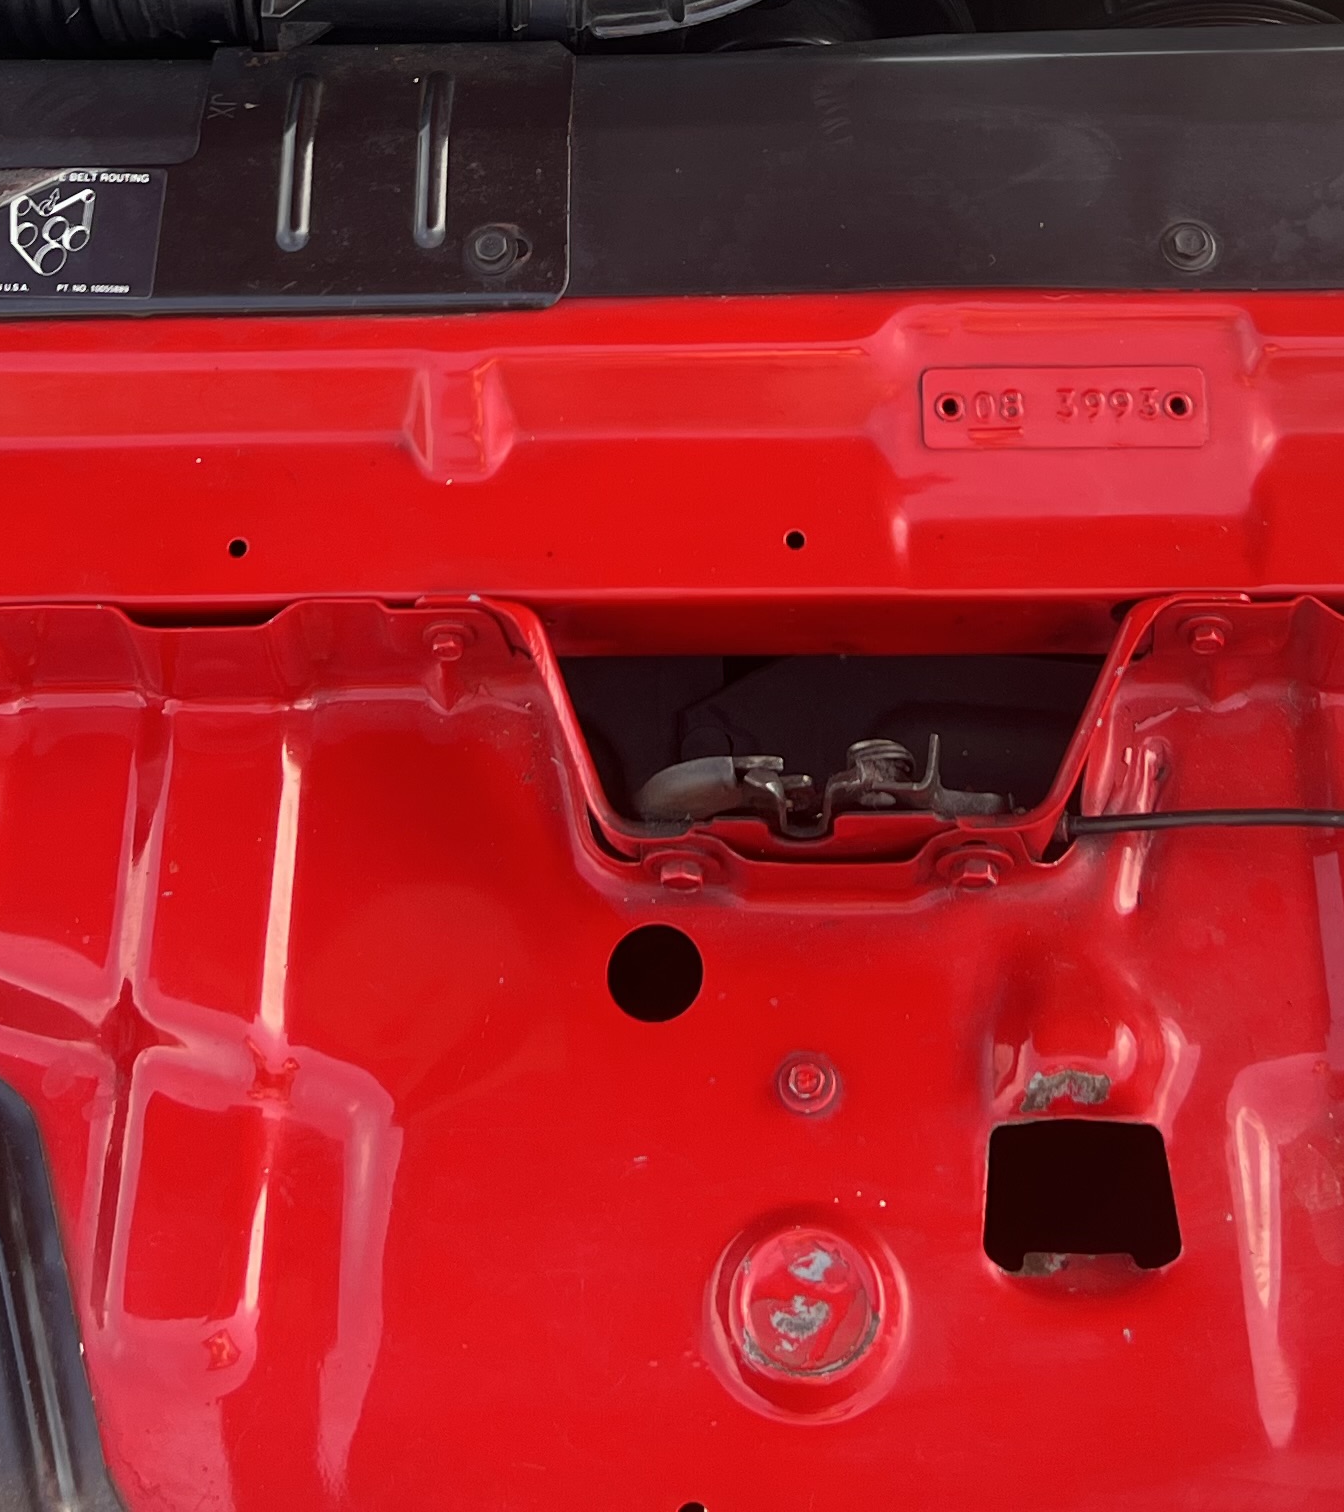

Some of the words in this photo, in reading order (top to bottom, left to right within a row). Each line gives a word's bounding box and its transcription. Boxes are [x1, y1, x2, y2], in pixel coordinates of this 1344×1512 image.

[68, 172, 96, 182] BELT
[99, 172, 150, 183] ROUTING
[3, 282, 30, 292] U.S.A.
[973, 388, 1023, 423] 08
[1054, 387, 1158, 422] 3993
